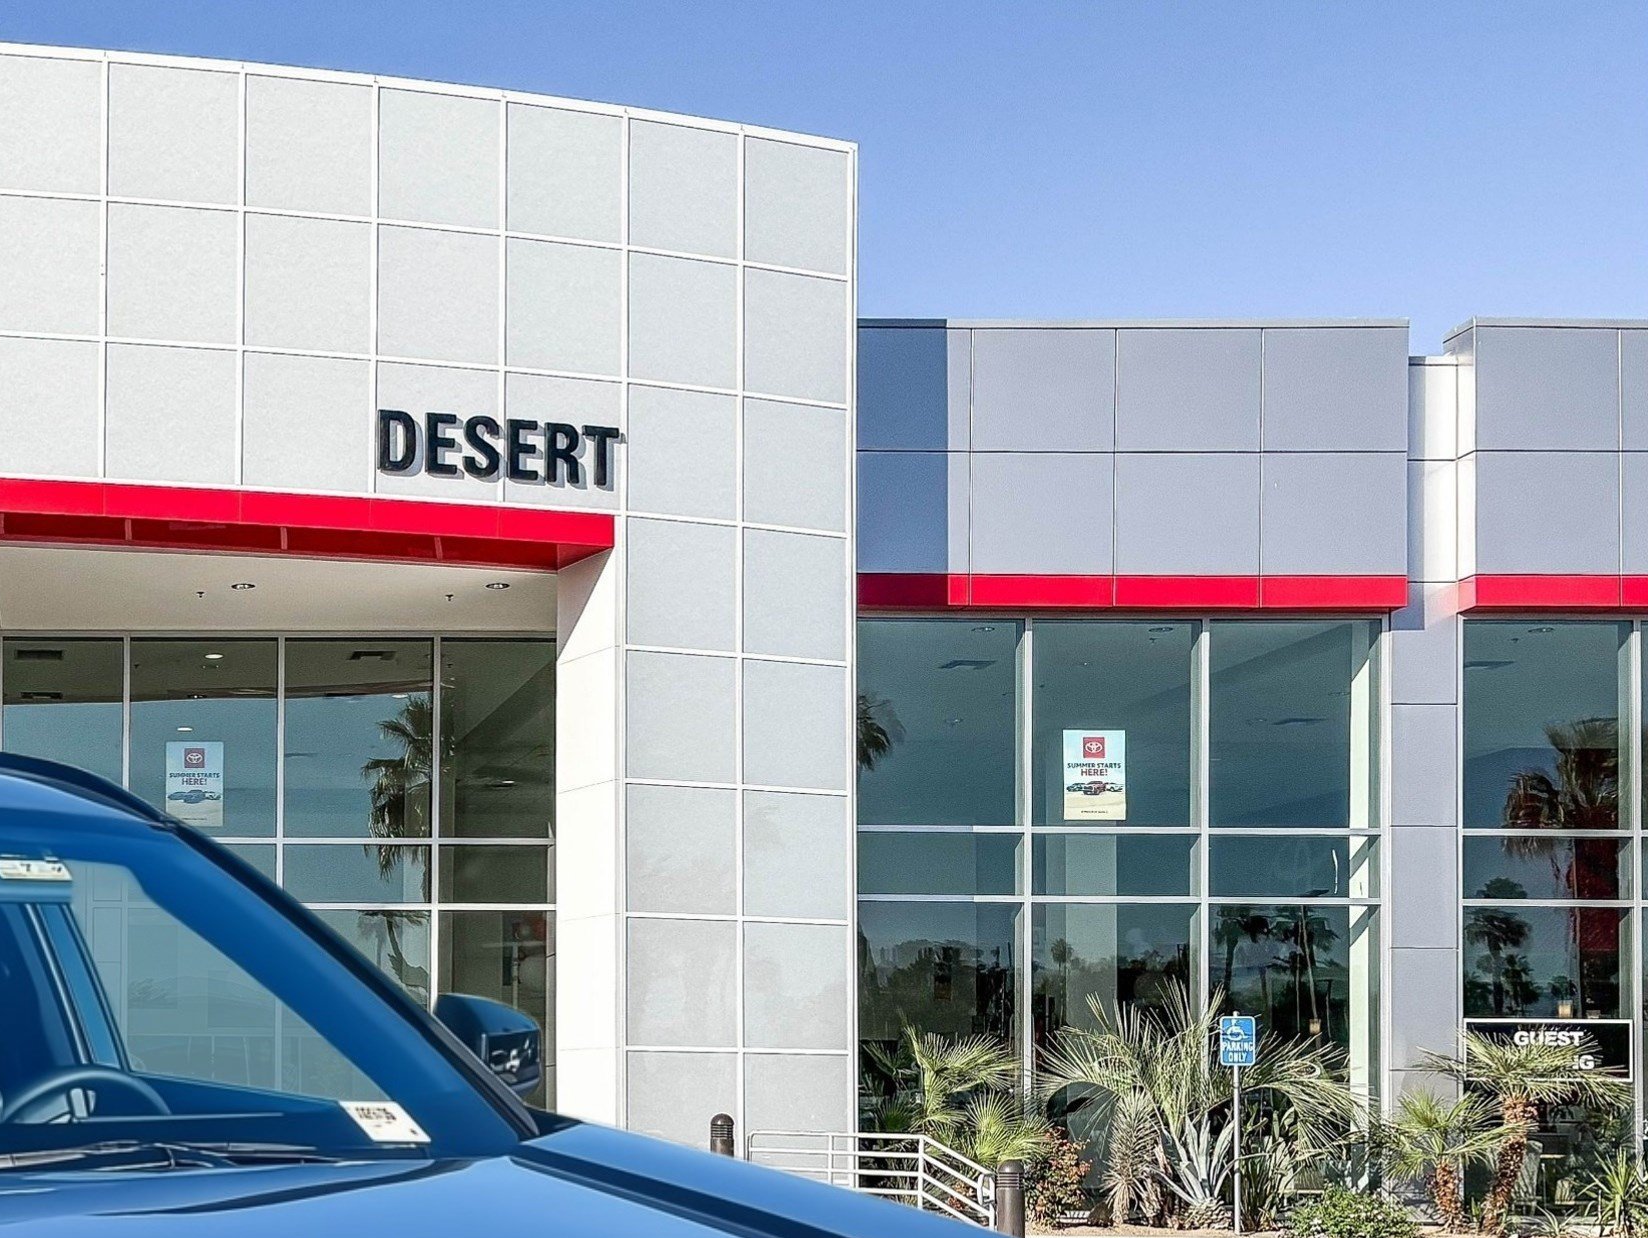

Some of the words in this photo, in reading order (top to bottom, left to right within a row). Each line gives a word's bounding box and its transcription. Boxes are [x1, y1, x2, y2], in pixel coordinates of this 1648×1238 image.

[377, 409, 620, 487] DESERT
[1080, 768, 1108, 776] HERE!
[1513, 1031, 1584, 1046] GUEST
[1222, 1041, 1254, 1052] PARKING
[1228, 1052, 1248, 1062] ONLY
